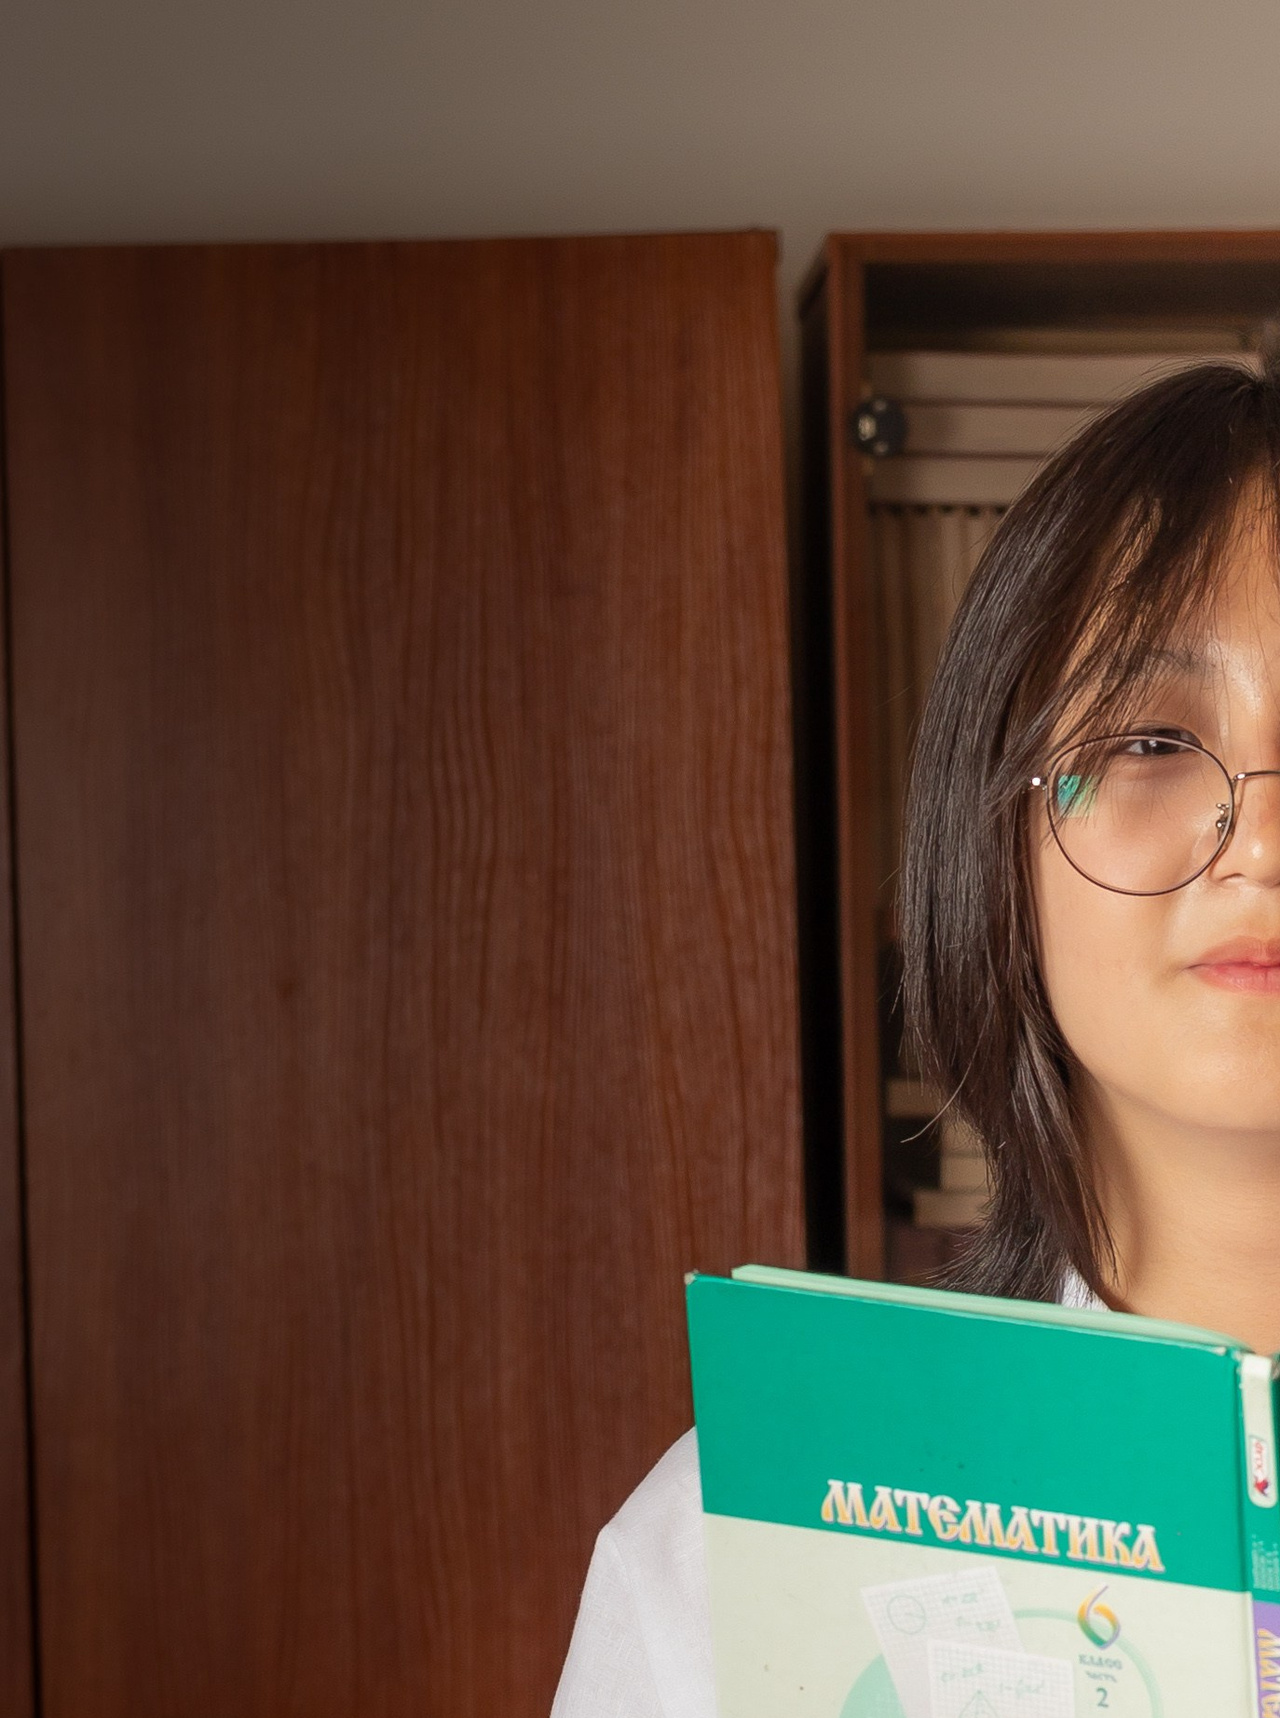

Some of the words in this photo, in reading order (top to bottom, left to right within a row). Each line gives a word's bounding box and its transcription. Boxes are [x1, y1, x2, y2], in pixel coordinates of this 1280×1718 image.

[820, 1478, 1166, 1574] МАТЕМАТИКА
[1077, 1582, 1122, 1650] 6
[1095, 1686, 1110, 1708] 2
